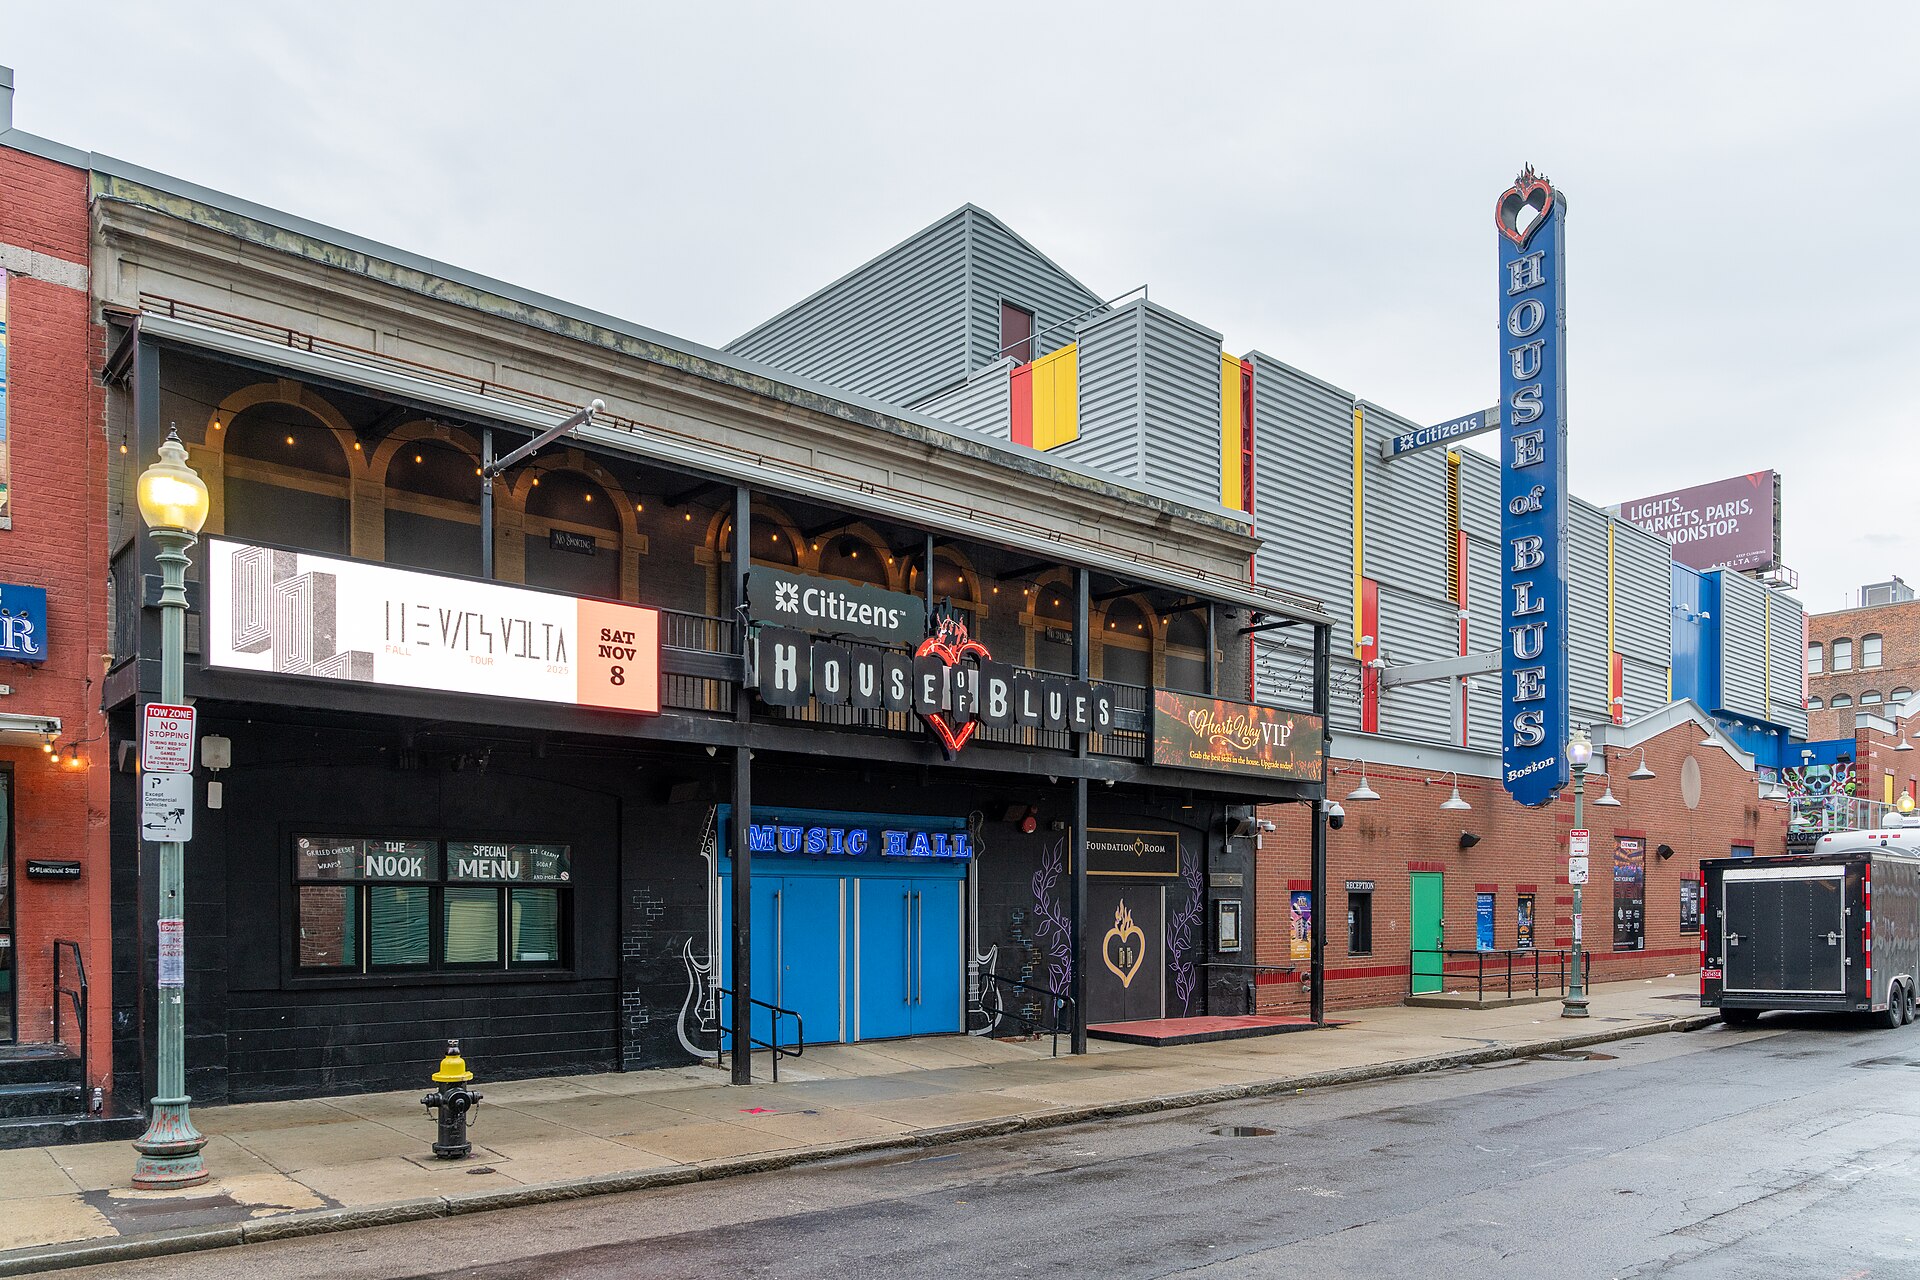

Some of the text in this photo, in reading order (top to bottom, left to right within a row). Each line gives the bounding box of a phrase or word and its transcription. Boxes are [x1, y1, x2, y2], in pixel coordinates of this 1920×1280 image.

[1416, 416, 1478, 446] Citizens
[1506, 250, 1548, 748] HOUSE of BLUES
[1630, 496, 1684, 521] LIGHTS,
[1706, 498, 1754, 522] PARIS,
[1666, 517, 1740, 546] NONSTOP.
[802, 588, 899, 629] Citizens
[600, 627, 635, 645] SAT
[385, 644, 569, 675] FALL TOUR 2025
[598, 644, 637, 661] NOV
[610, 665, 625, 686] 8
[774, 643, 1110, 726] HOUSE OF BLUES
[149, 708, 192, 719] TOW ZONE
[149, 731, 189, 740] STOPPING
[160, 721, 178, 731] NO
[1260, 721, 1291, 747] VIP
[1189, 750, 1202, 759] Grab
[1507, 755, 1556, 783] Boston
[384, 841, 406, 853] THE
[473, 844, 507, 857] SPECIAL
[749, 824, 973, 858] MUSIC HALL
[1086, 840, 1166, 853] FOUNDATION ROOM
[366, 855, 422, 877] NOOK
[458, 858, 520, 879] MENU
[1345, 881, 1374, 890] RECEPTION
